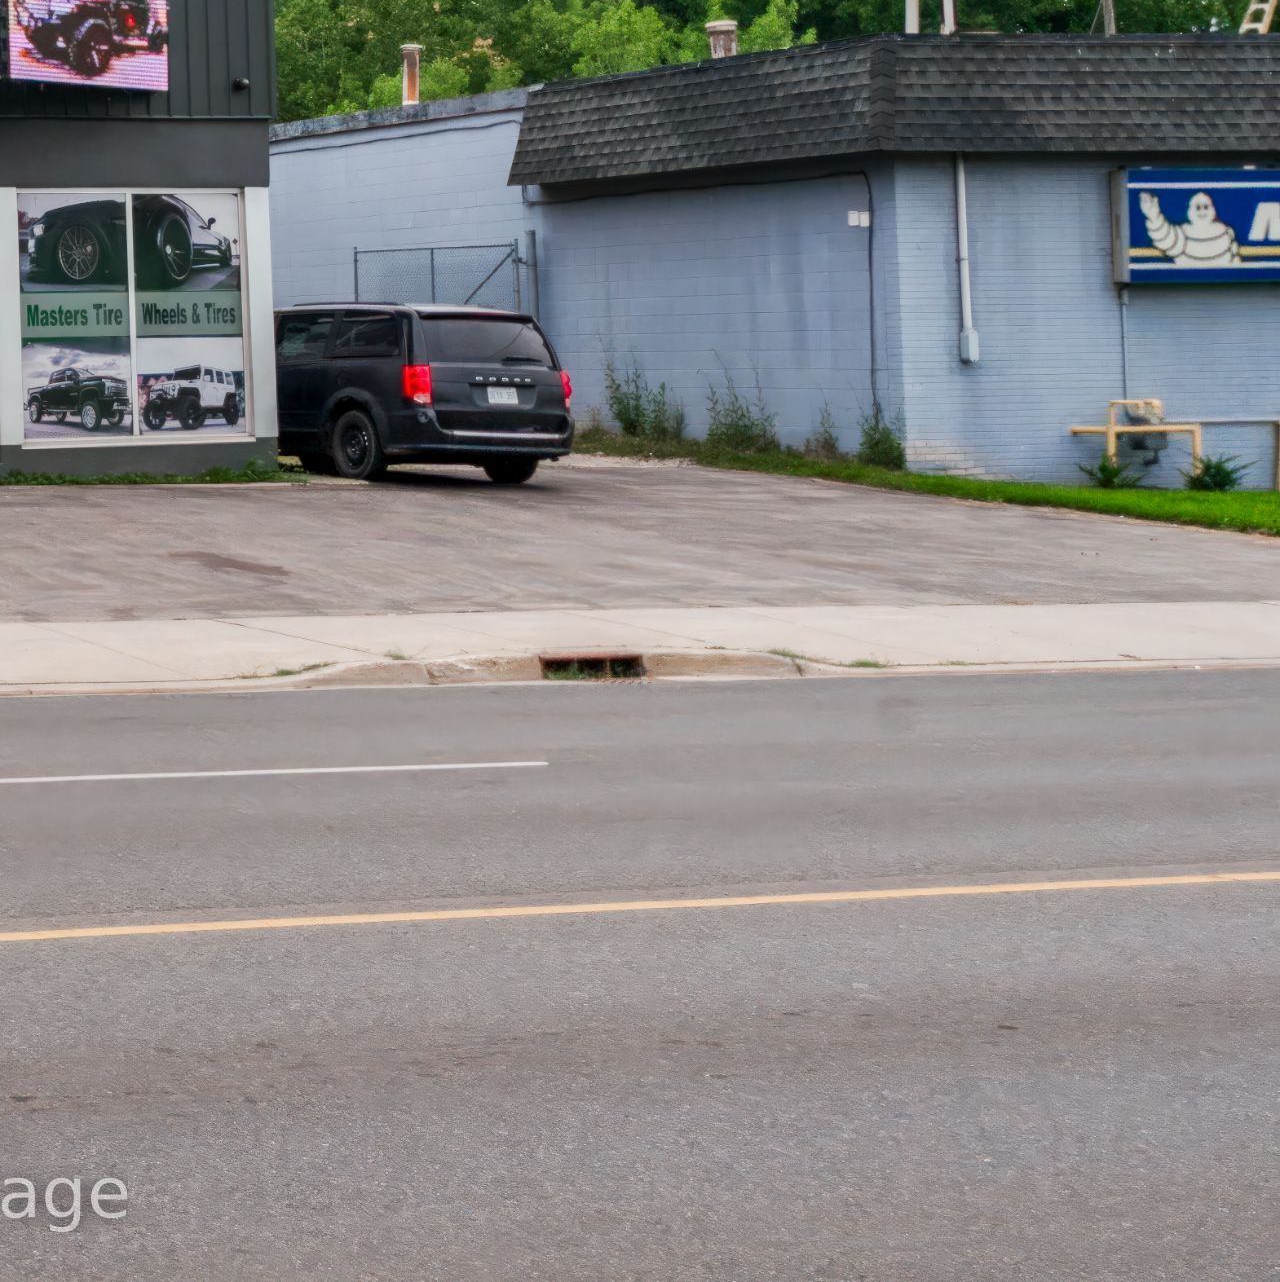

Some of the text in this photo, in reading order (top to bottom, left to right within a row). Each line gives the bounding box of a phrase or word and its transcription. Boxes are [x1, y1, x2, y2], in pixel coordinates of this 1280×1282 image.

[26, 303, 123, 327] Masters Tire
[141, 302, 236, 325] Wheels & Tires
